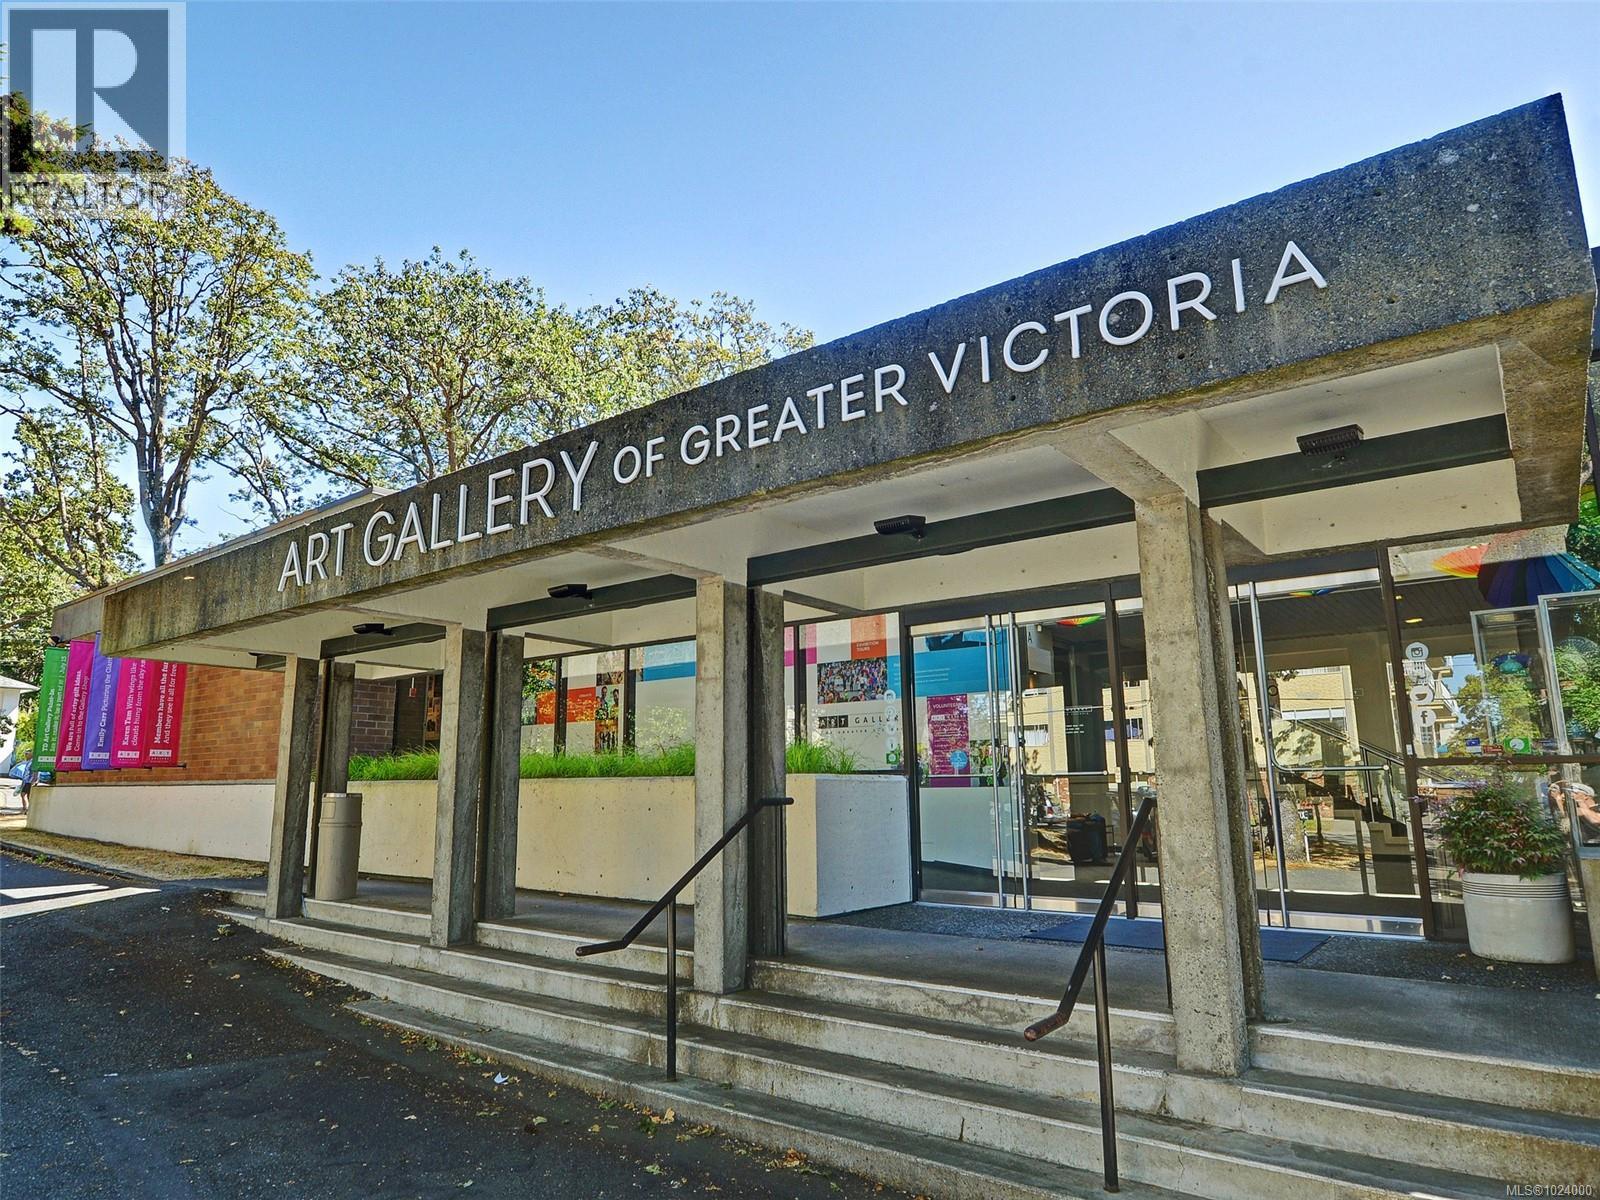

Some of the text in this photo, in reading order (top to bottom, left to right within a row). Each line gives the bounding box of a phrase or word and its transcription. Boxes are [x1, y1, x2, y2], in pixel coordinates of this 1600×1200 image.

[277, 240, 1328, 592] ART GALLERY OF GREATER VICTORIA
[128, 674, 137, 694] wings
[79, 691, 88, 710] Gallery
[101, 685, 112, 712] Picturing
[157, 695, 166, 712] have
[44, 712, 54, 732] Gallery
[124, 710, 132, 725] Tam
[134, 707, 142, 724] hung
[164, 714, 174, 729] they
[818, 716, 848, 729] ART
[98, 728, 106, 747] Emily
[122, 726, 130, 746] Karen
[132, 725, 140, 746] clouds
[154, 712, 164, 744] Members
[65, 742, 72, 752] We
